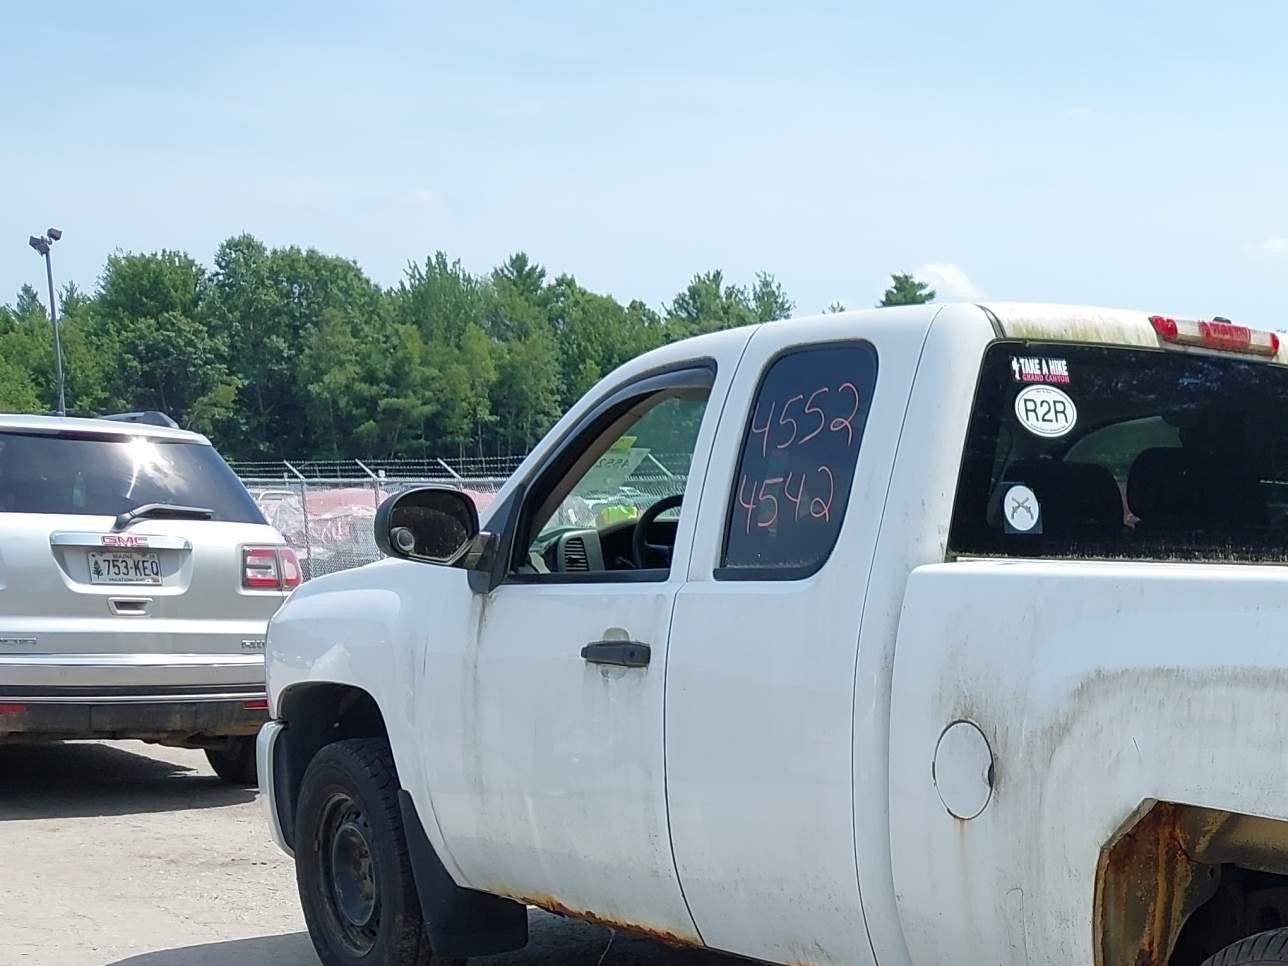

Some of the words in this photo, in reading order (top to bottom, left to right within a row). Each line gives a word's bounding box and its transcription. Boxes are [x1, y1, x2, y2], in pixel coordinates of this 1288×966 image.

[1020, 358, 1041, 374] TAKE
[1042, 358, 1049, 375] A
[1049, 359, 1069, 376] HIKE
[751, 382, 859, 457] 4552
[1024, 398, 1068, 424] R2R
[738, 466, 835, 535] 4542
[101, 536, 148, 547] GMC
